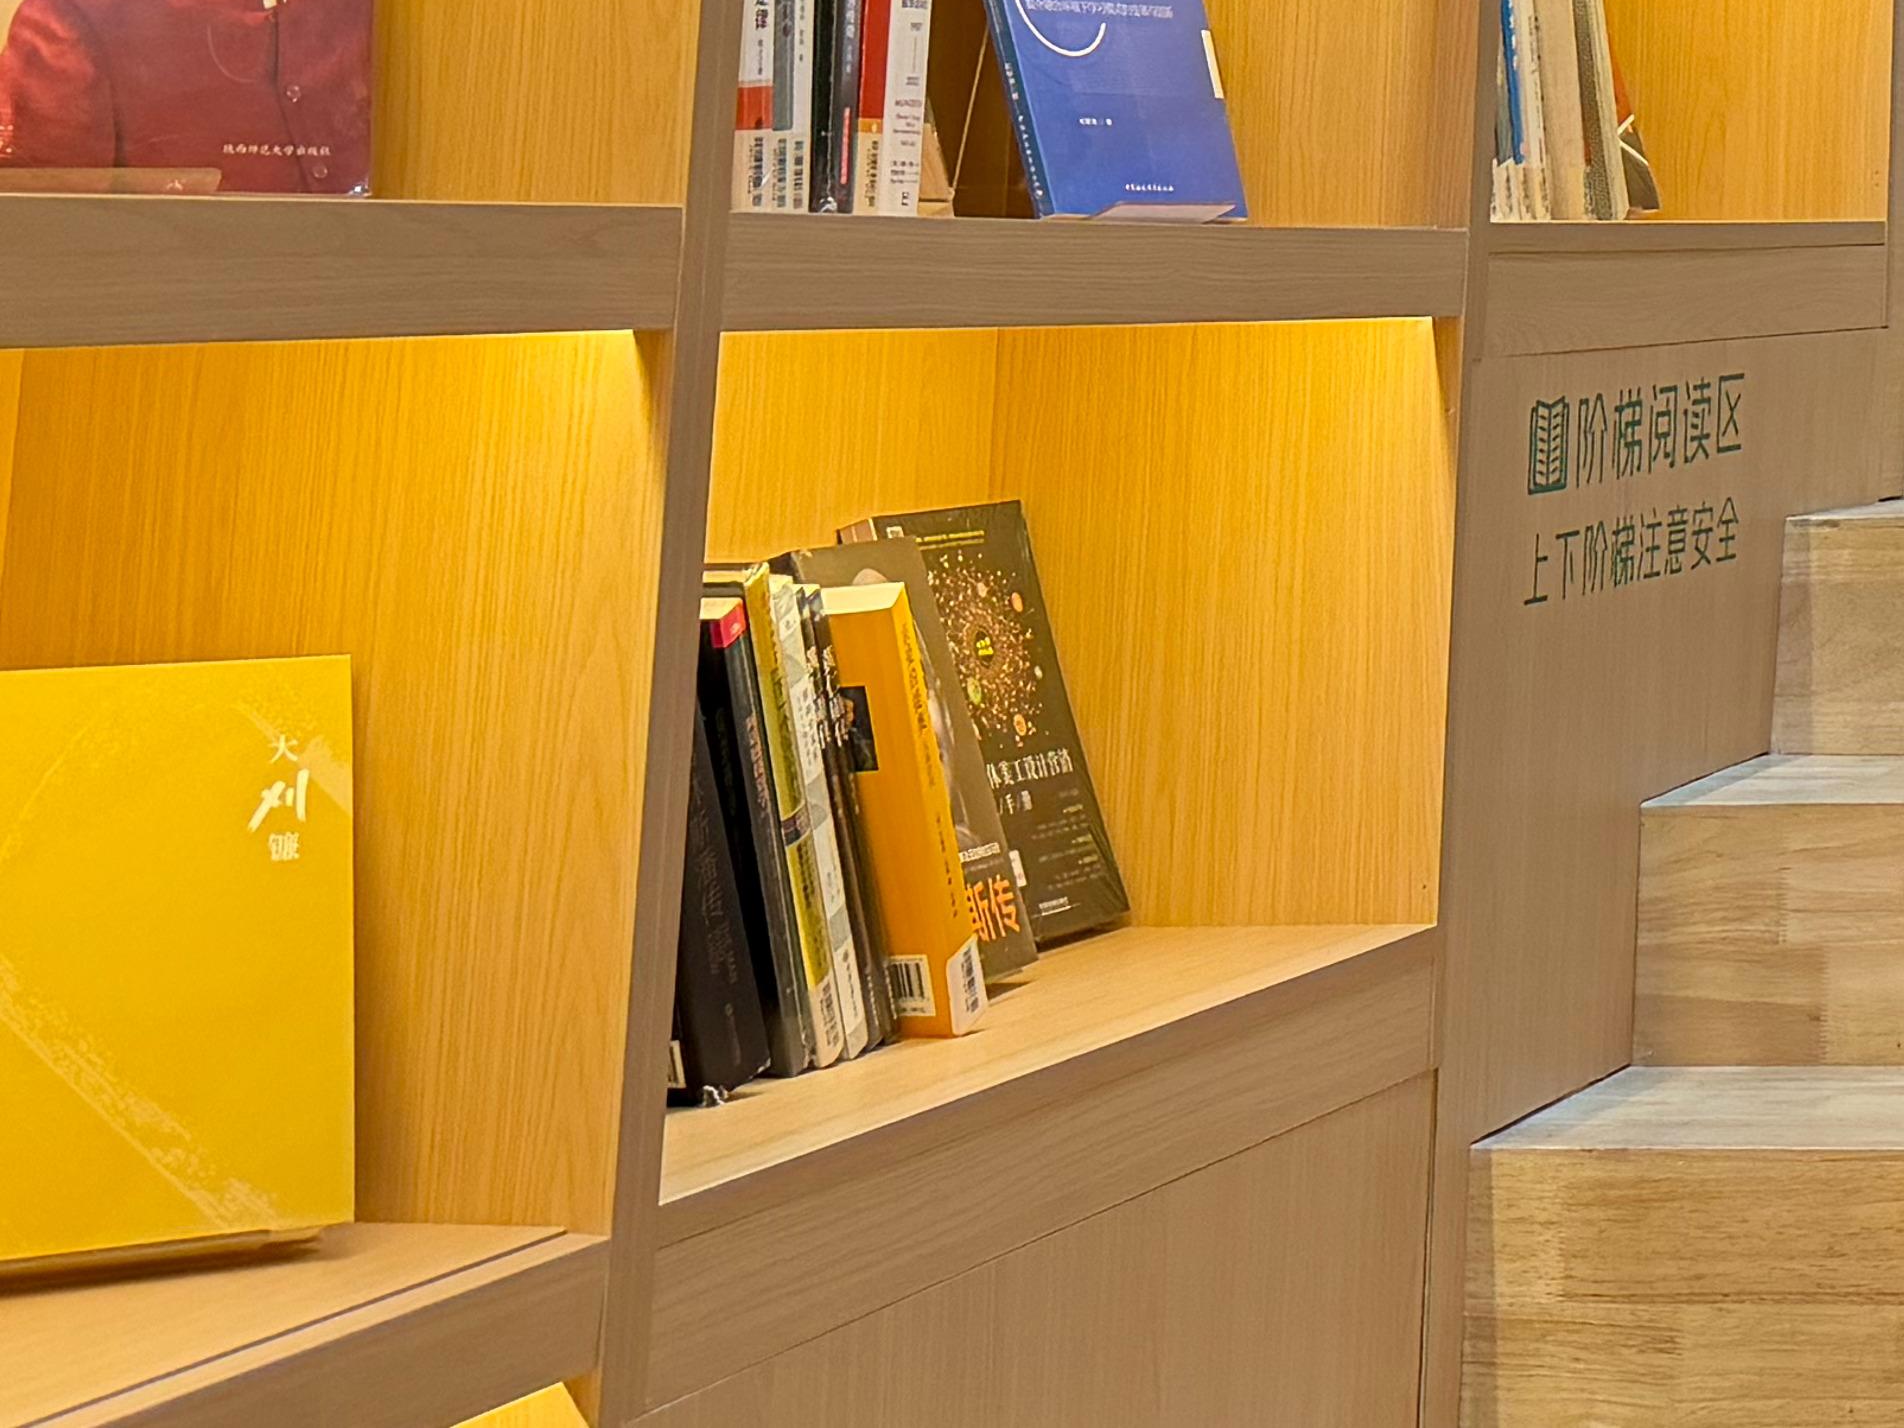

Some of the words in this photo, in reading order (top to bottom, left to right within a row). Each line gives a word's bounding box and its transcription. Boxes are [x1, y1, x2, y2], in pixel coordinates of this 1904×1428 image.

[1575, 372, 1745, 489] 阶梯阅读区
[1523, 496, 1740, 607] 上下阶梯注意安全
